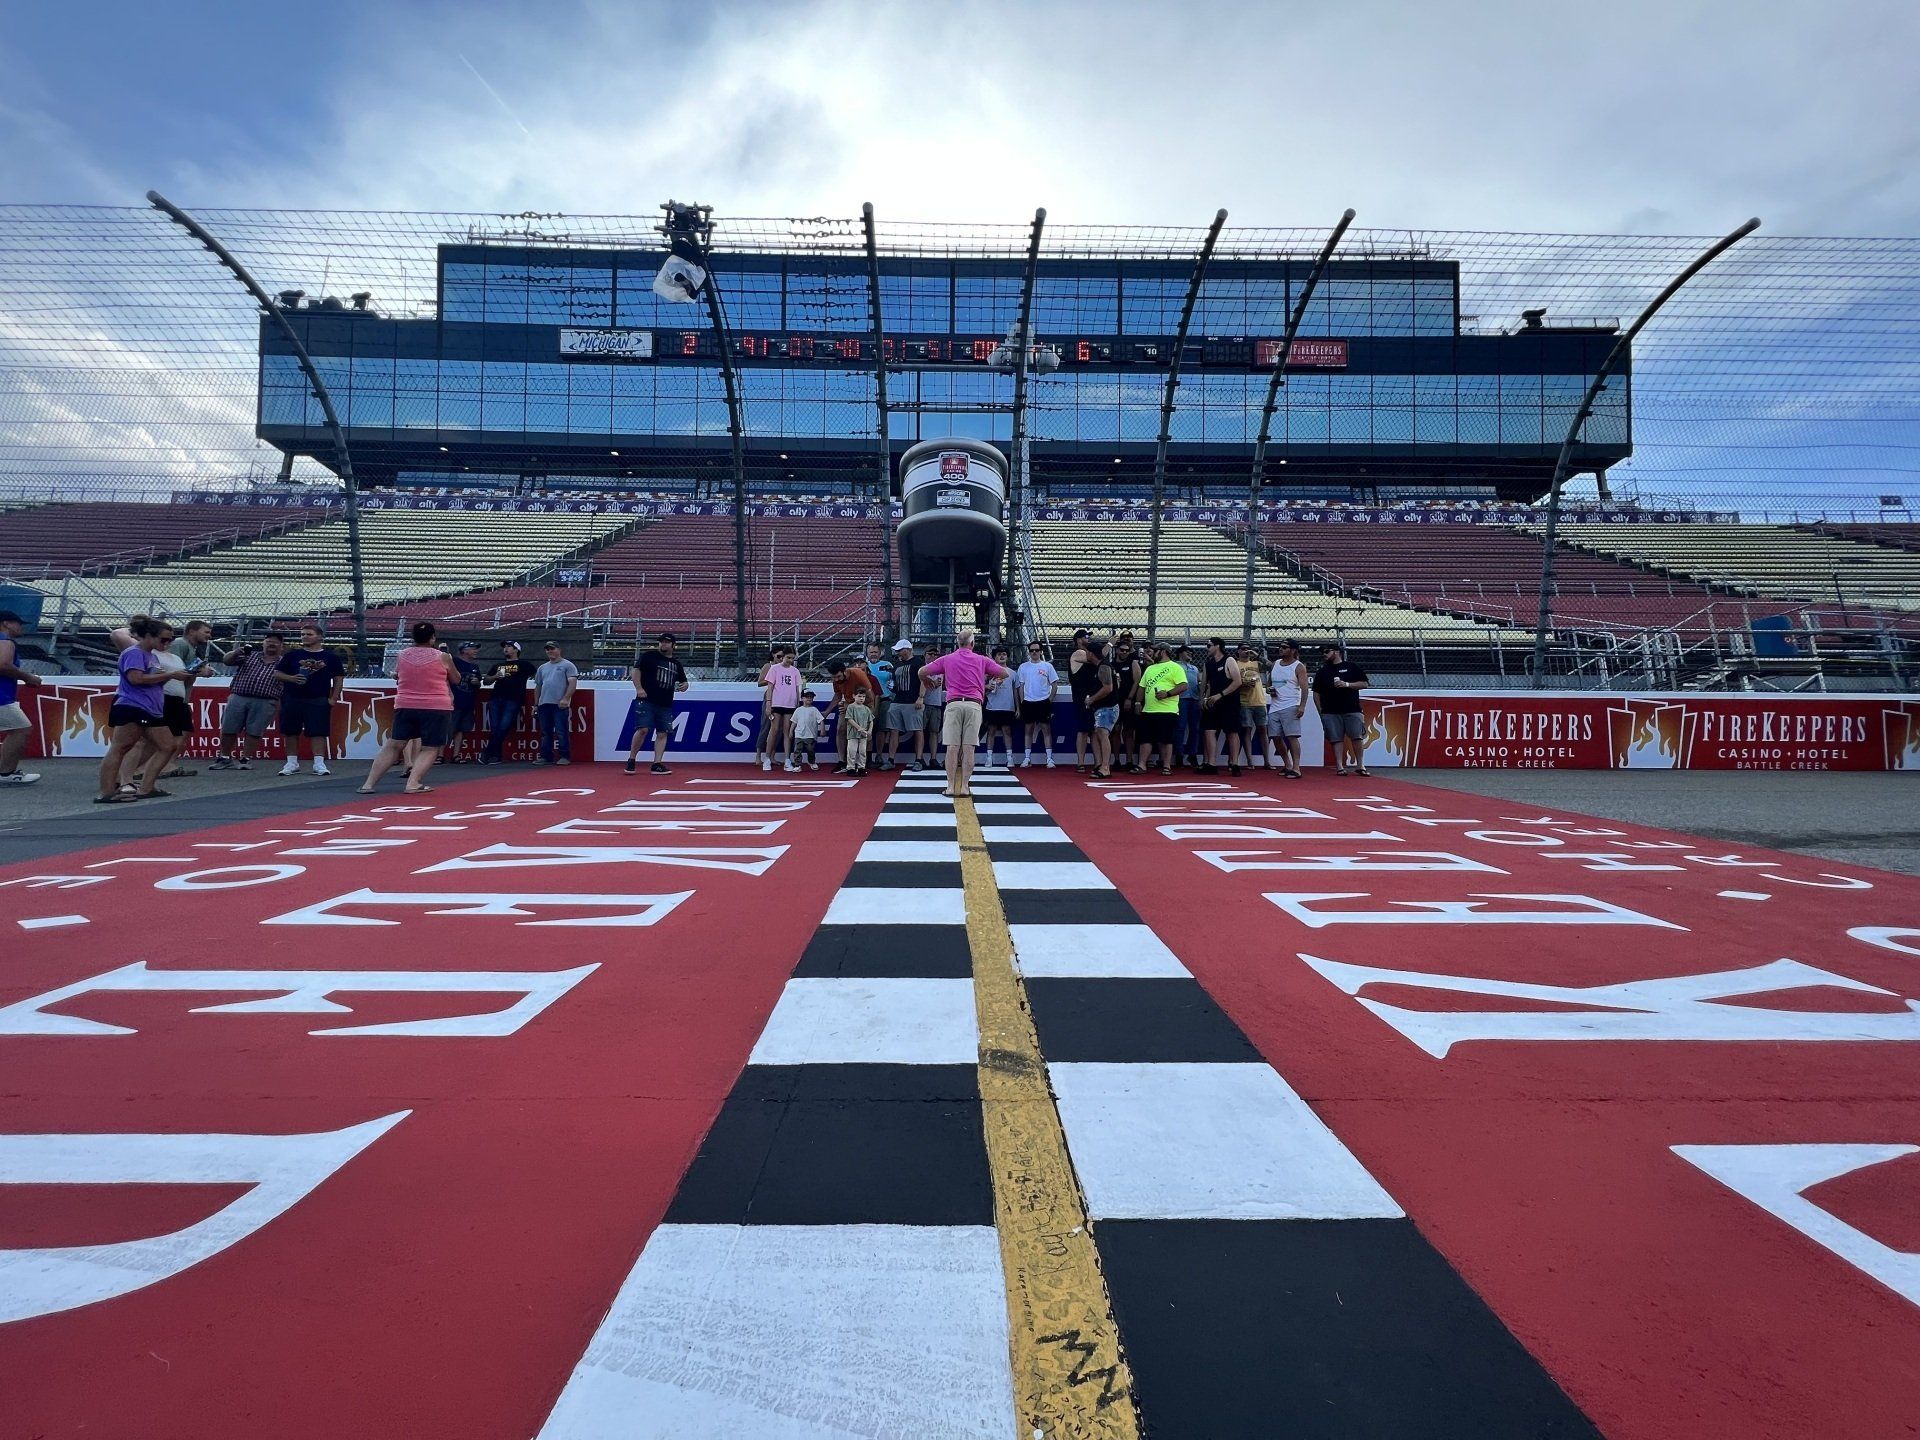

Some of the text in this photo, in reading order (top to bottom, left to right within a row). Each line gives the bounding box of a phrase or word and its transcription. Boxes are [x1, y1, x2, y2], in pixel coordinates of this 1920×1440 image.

[579, 335, 629, 350] MICHIGAN
[684, 335, 695, 354] 2
[1078, 341, 1090, 360] 6
[1146, 347, 1157, 355] 10
[204, 495, 224, 506] ally
[259, 496, 278, 507] ally
[313, 497, 332, 508] ally
[367, 498, 385, 510] ally
[419, 499, 438, 510] ally
[474, 502, 494, 512] ally
[527, 502, 547, 513] ally
[579, 503, 598, 513] ally
[631, 503, 650, 514] ally
[683, 504, 702, 515] ally
[743, 505, 756, 517] lly
[789, 506, 808, 518] ally
[840, 507, 859, 518] ally
[891, 507, 904, 518] all
[1046, 510, 1064, 521] ally
[1096, 510, 1115, 521] ally
[1198, 511, 1217, 522] ally
[1256, 511, 1270, 522] lly
[1302, 511, 1320, 522] ally
[1353, 512, 1371, 523] ally
[1404, 512, 1422, 523] ally
[1454, 512, 1473, 523] ally
[1509, 513, 1526, 524] ally
[1560, 513, 1578, 524] ally
[1611, 513, 1630, 524] ally
[1663, 513, 1681, 524] ally
[1715, 514, 1733, 524] ally
[1429, 709, 1593, 741] FIREKEEPERS
[1702, 711, 1867, 742] FIREKEEPERS
[178, 749, 221, 758] ATTLE
[511, 752, 542, 761] CREE
[1445, 746, 1576, 757] CASINO HOTEL
[1718, 748, 1849, 759] CASINO HOTEL
[1464, 759, 1556, 768] BATTLE CREEK
[1737, 761, 1829, 770] BATTLE CREEK
[153, 787, 596, 891] CASINO
[1333, 795, 1687, 872] HOTEL
[1499, 815, 1875, 889] CREEK
